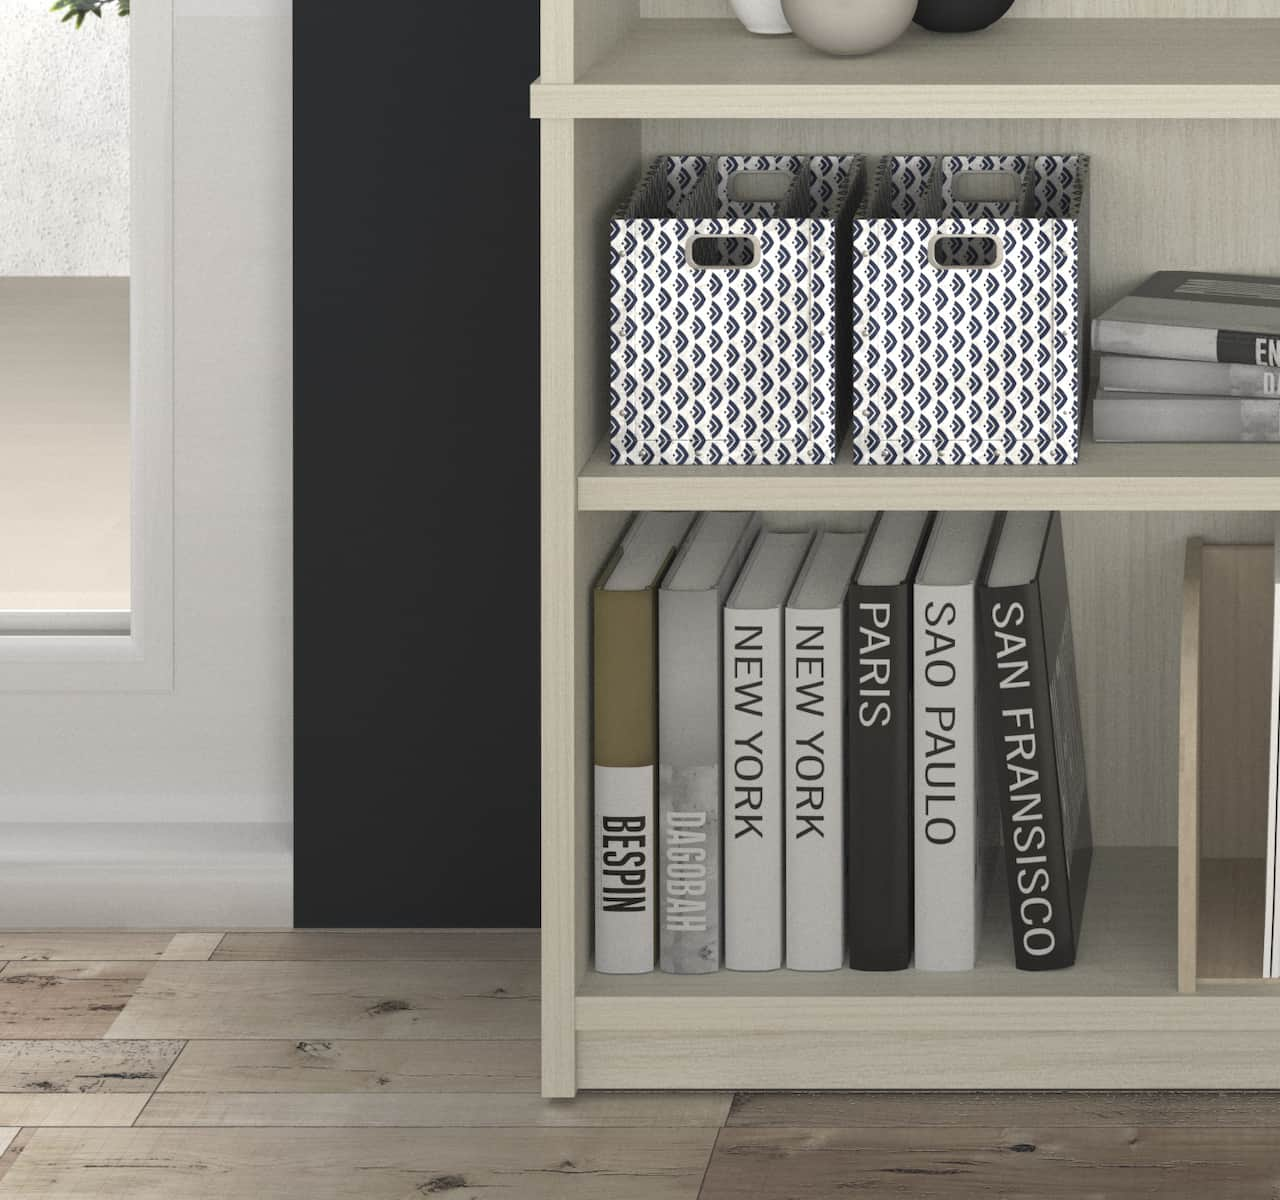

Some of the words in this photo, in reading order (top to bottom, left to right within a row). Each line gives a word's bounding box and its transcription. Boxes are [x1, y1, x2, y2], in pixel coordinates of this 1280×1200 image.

[734, 625, 763, 717] NEW
[795, 625, 825, 717] NEW
[859, 602, 891, 728] PARIS
[924, 601, 956, 688] SAO
[991, 602, 1031, 690] SAN
[734, 730, 763, 840] YORK
[795, 730, 825, 840] YORK
[924, 706, 956, 845] PAULO
[602, 815, 646, 913] BESPIN
[665, 811, 706, 932] DAGOBAH
[1002, 707, 1056, 957] FRANSISCO
